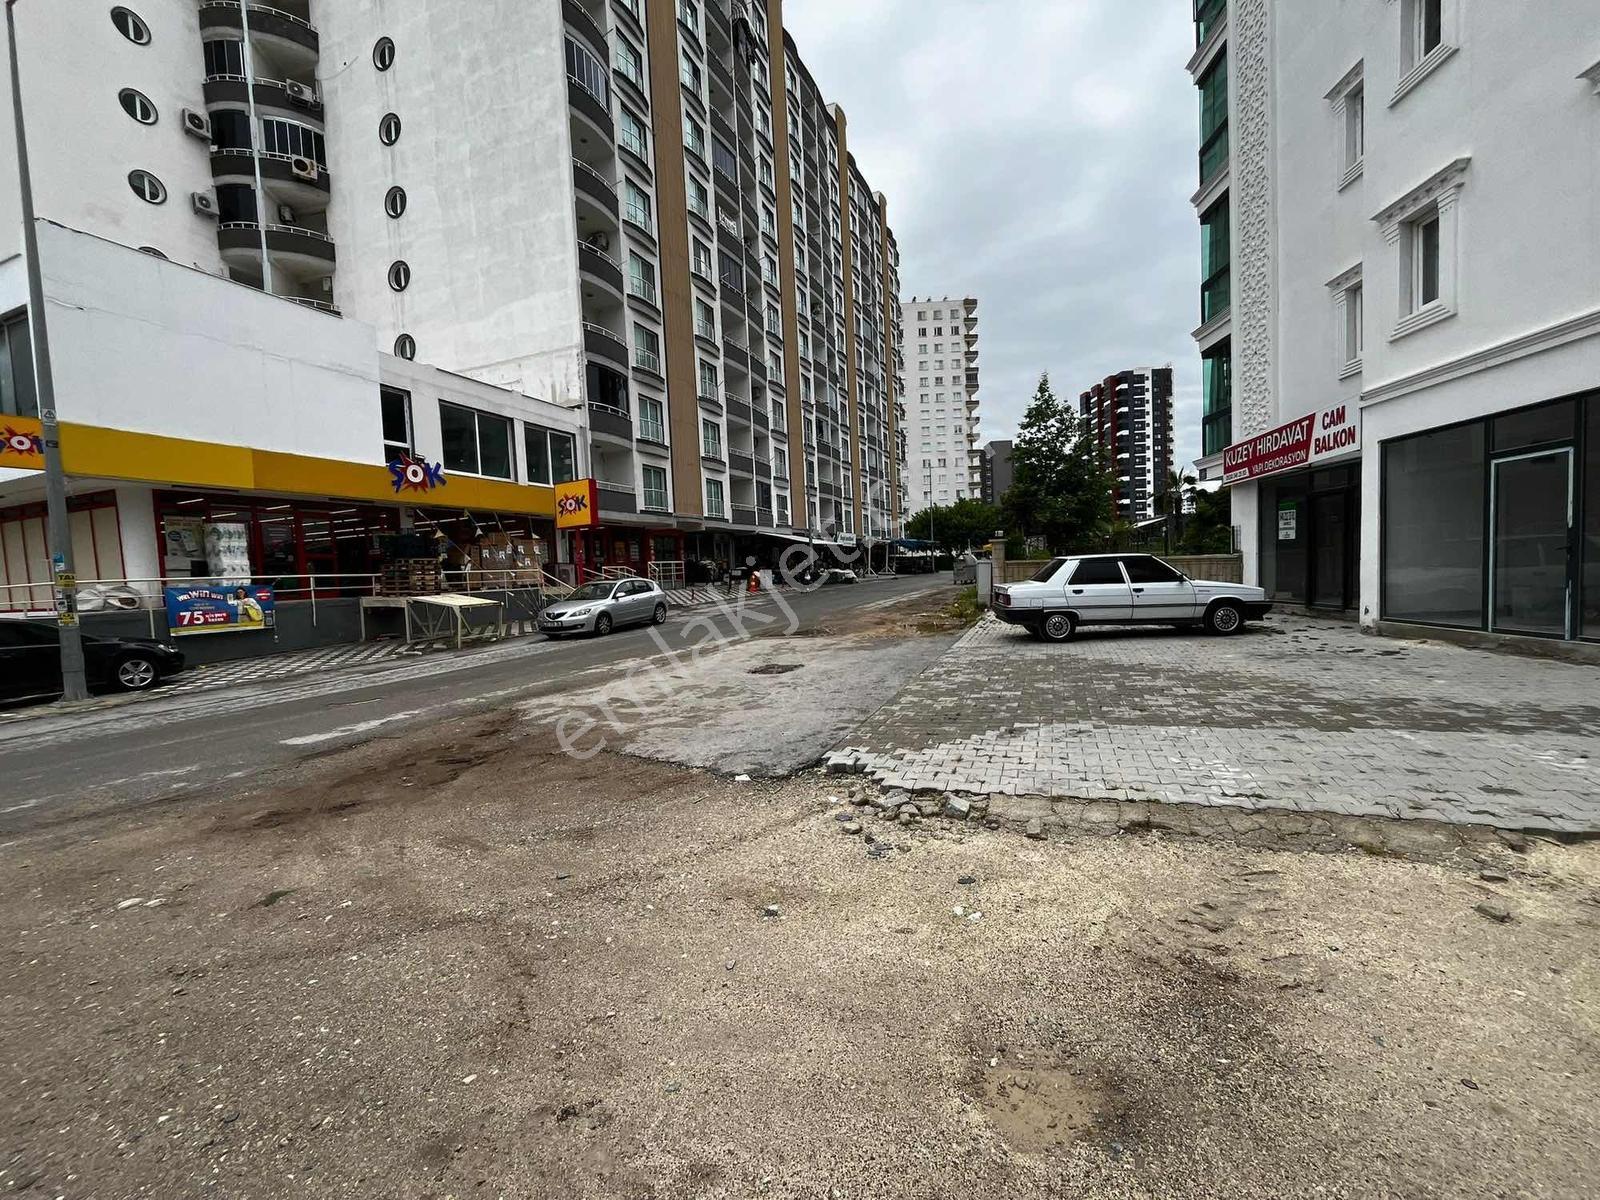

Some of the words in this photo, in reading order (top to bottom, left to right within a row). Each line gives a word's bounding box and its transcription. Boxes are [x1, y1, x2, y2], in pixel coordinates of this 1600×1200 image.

[1322, 405, 1346, 430] CAM
[1225, 442, 1255, 467] KUZEY
[1256, 420, 1309, 457] HIRDAVAT
[1314, 425, 1356, 455] BALKON
[388, 456, 448, 493] ŞOK
[180, 611, 205, 625] 75
